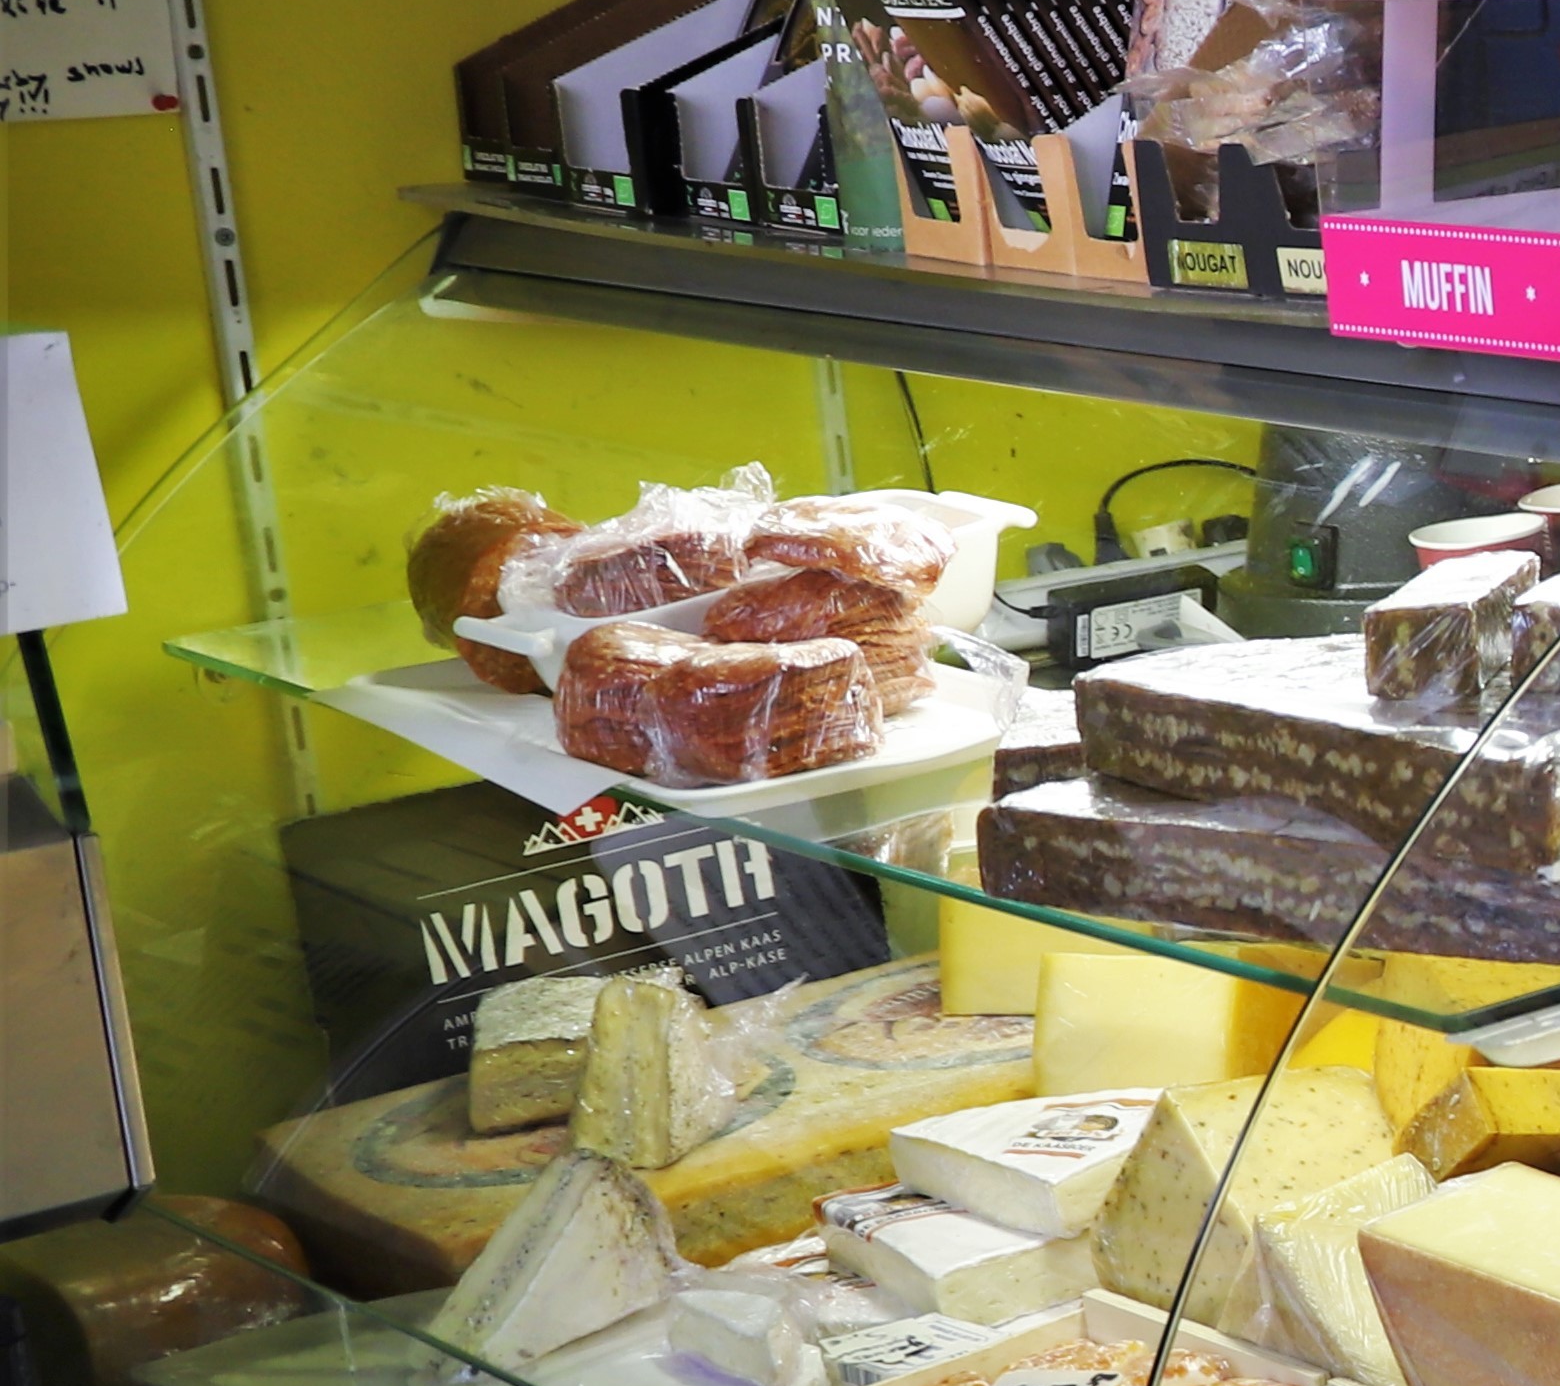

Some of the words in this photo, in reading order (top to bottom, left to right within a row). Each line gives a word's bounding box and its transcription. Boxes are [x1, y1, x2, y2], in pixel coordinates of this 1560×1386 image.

[1401, 258, 1495, 316] MUFFIN
[420, 839, 775, 985] MAGOTH
[684, 943, 736, 966] ALPEN
[740, 930, 781, 950] KAAS
